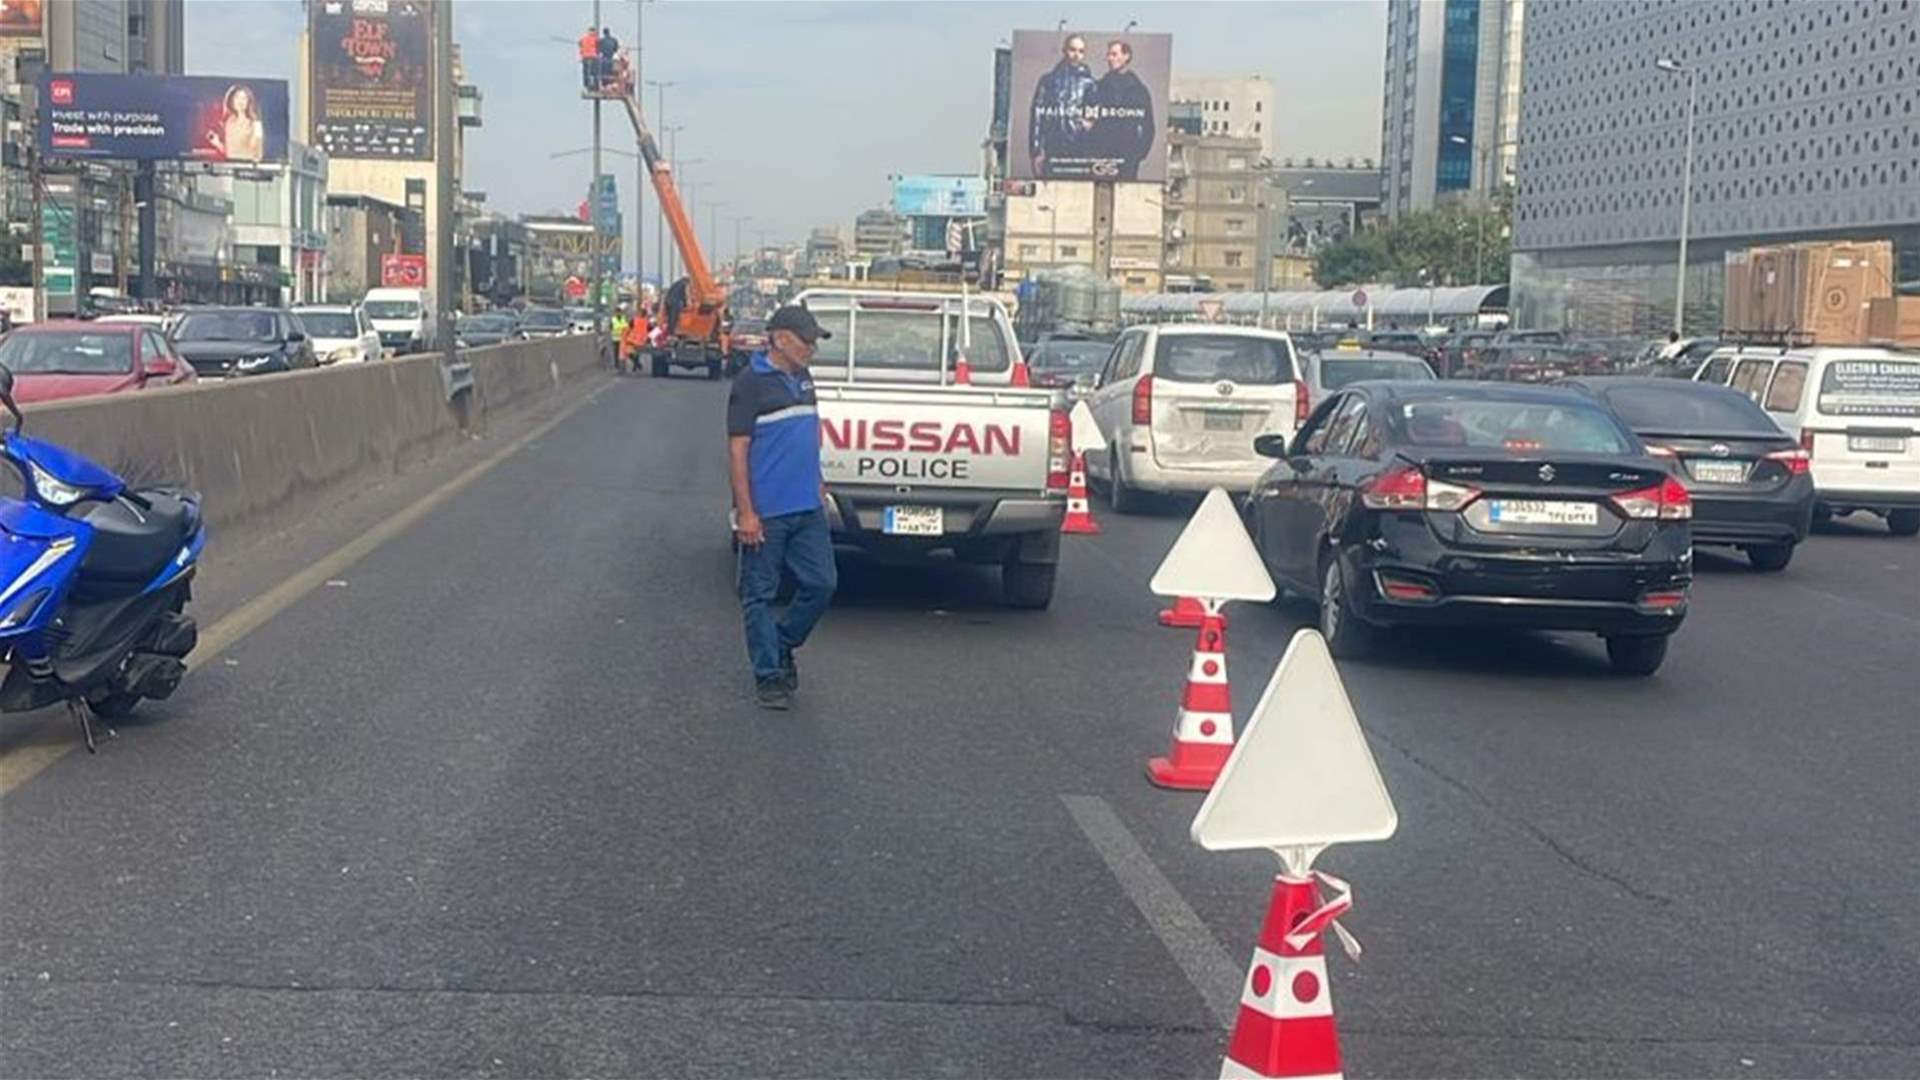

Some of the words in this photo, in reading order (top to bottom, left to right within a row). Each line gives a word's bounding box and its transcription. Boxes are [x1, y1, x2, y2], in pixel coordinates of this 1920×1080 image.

[88, 112, 111, 121] with
[113, 113, 159, 124] purpose
[1035, 105, 1082, 117] MAISON
[1101, 106, 1145, 118] BROWN
[51, 122, 85, 134] Trade
[87, 123, 112, 134] with
[114, 124, 165, 138] precision
[819, 418, 1021, 456] NISSAN
[857, 457, 969, 479] POLICE
